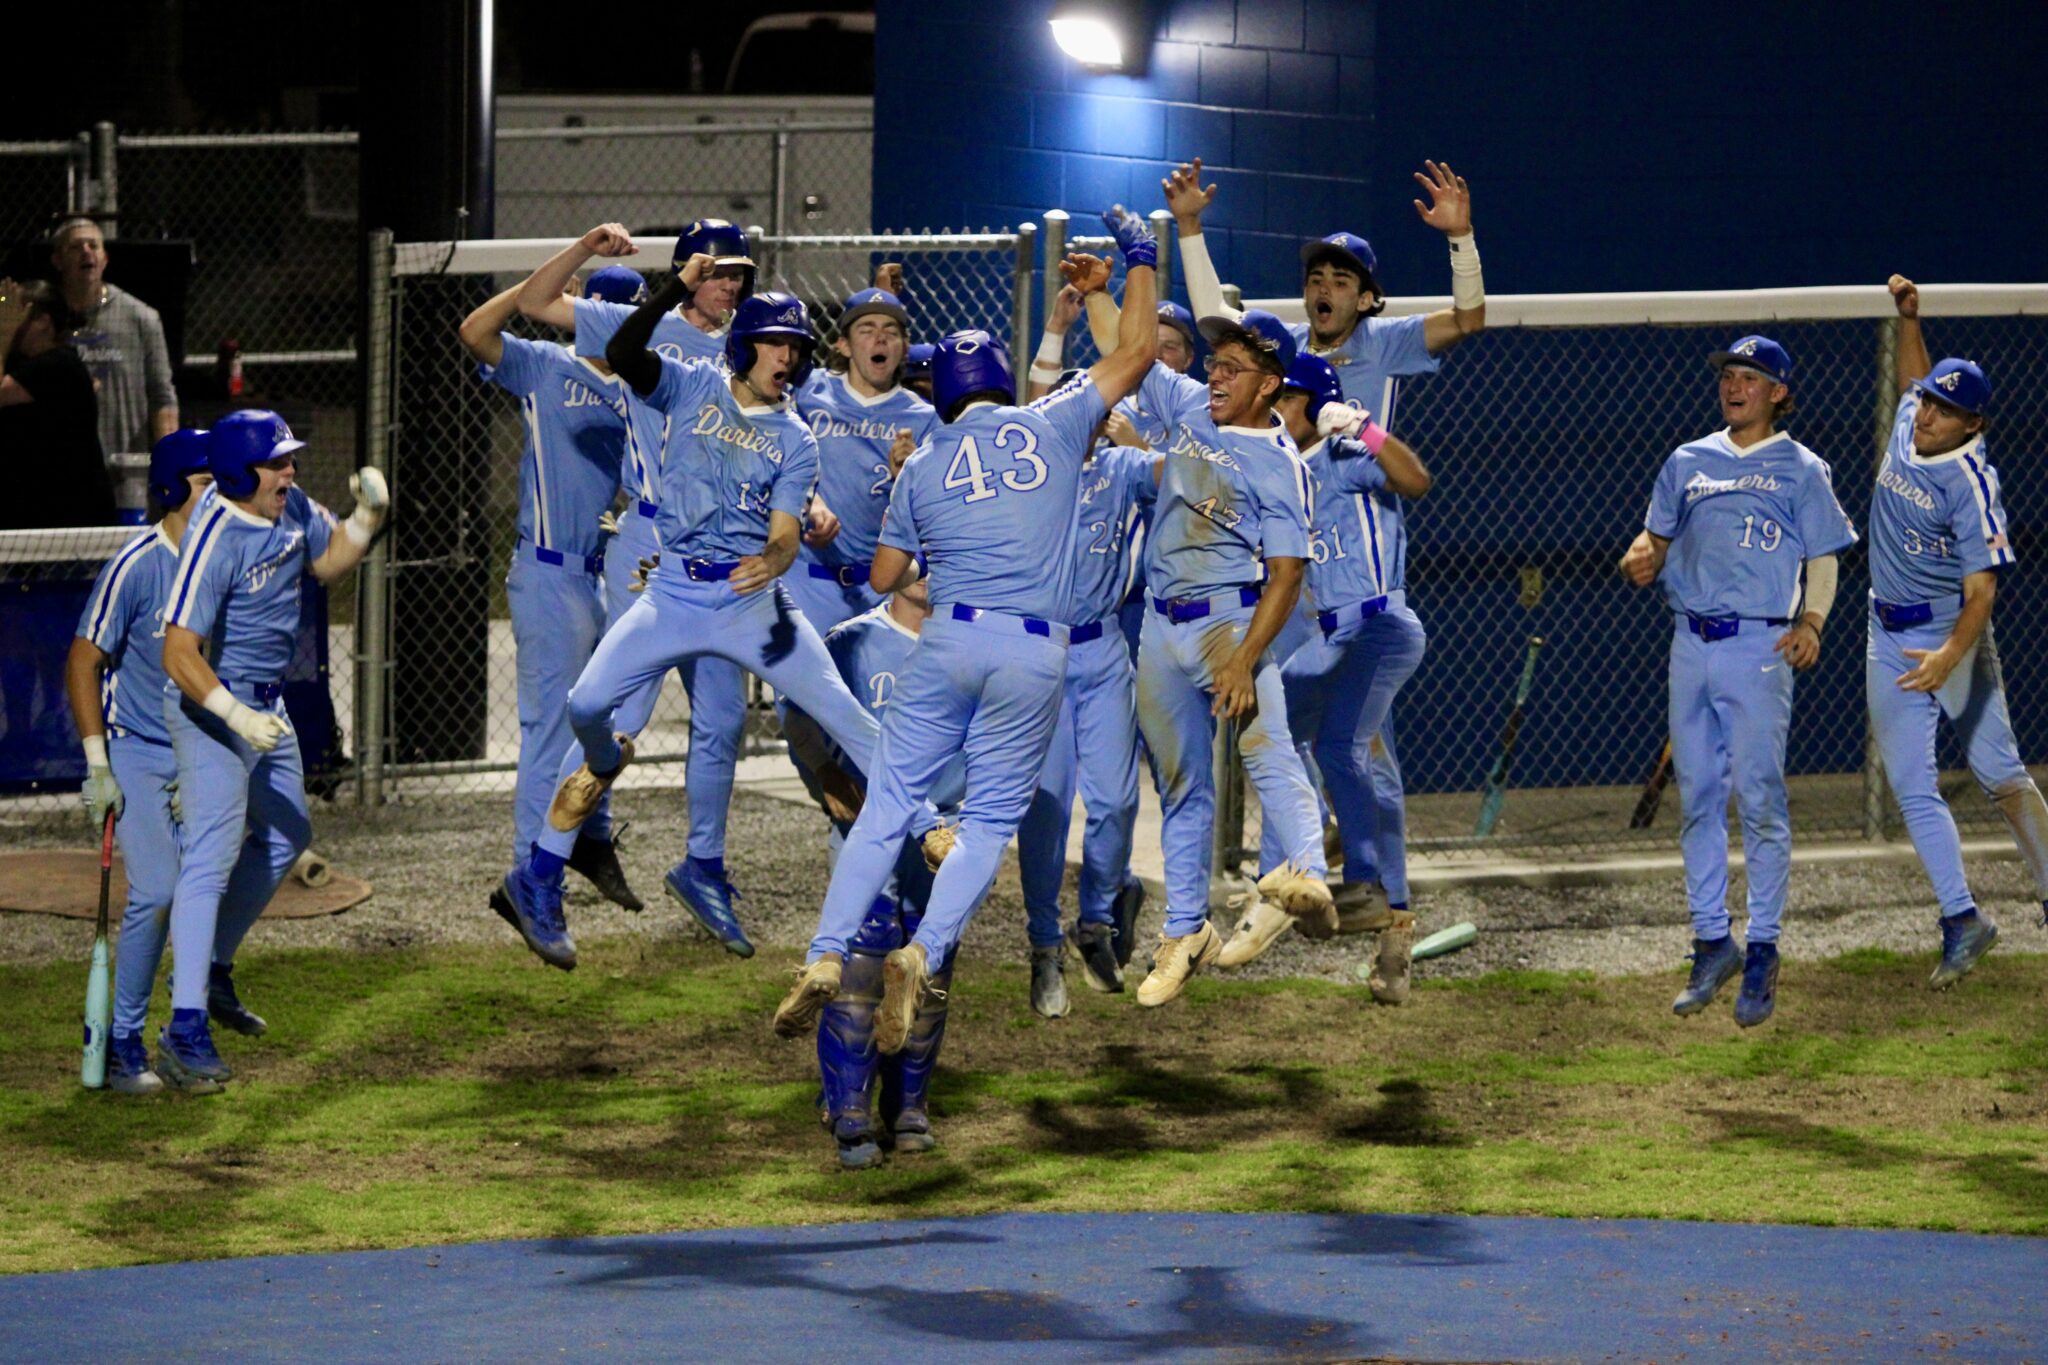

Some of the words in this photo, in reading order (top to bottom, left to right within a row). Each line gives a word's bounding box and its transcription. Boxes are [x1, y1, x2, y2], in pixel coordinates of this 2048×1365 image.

[807, 409, 897, 441] Darters
[943, 421, 1049, 504] 43
[1311, 523, 1347, 565] 51
[1739, 514, 1782, 552] 19
